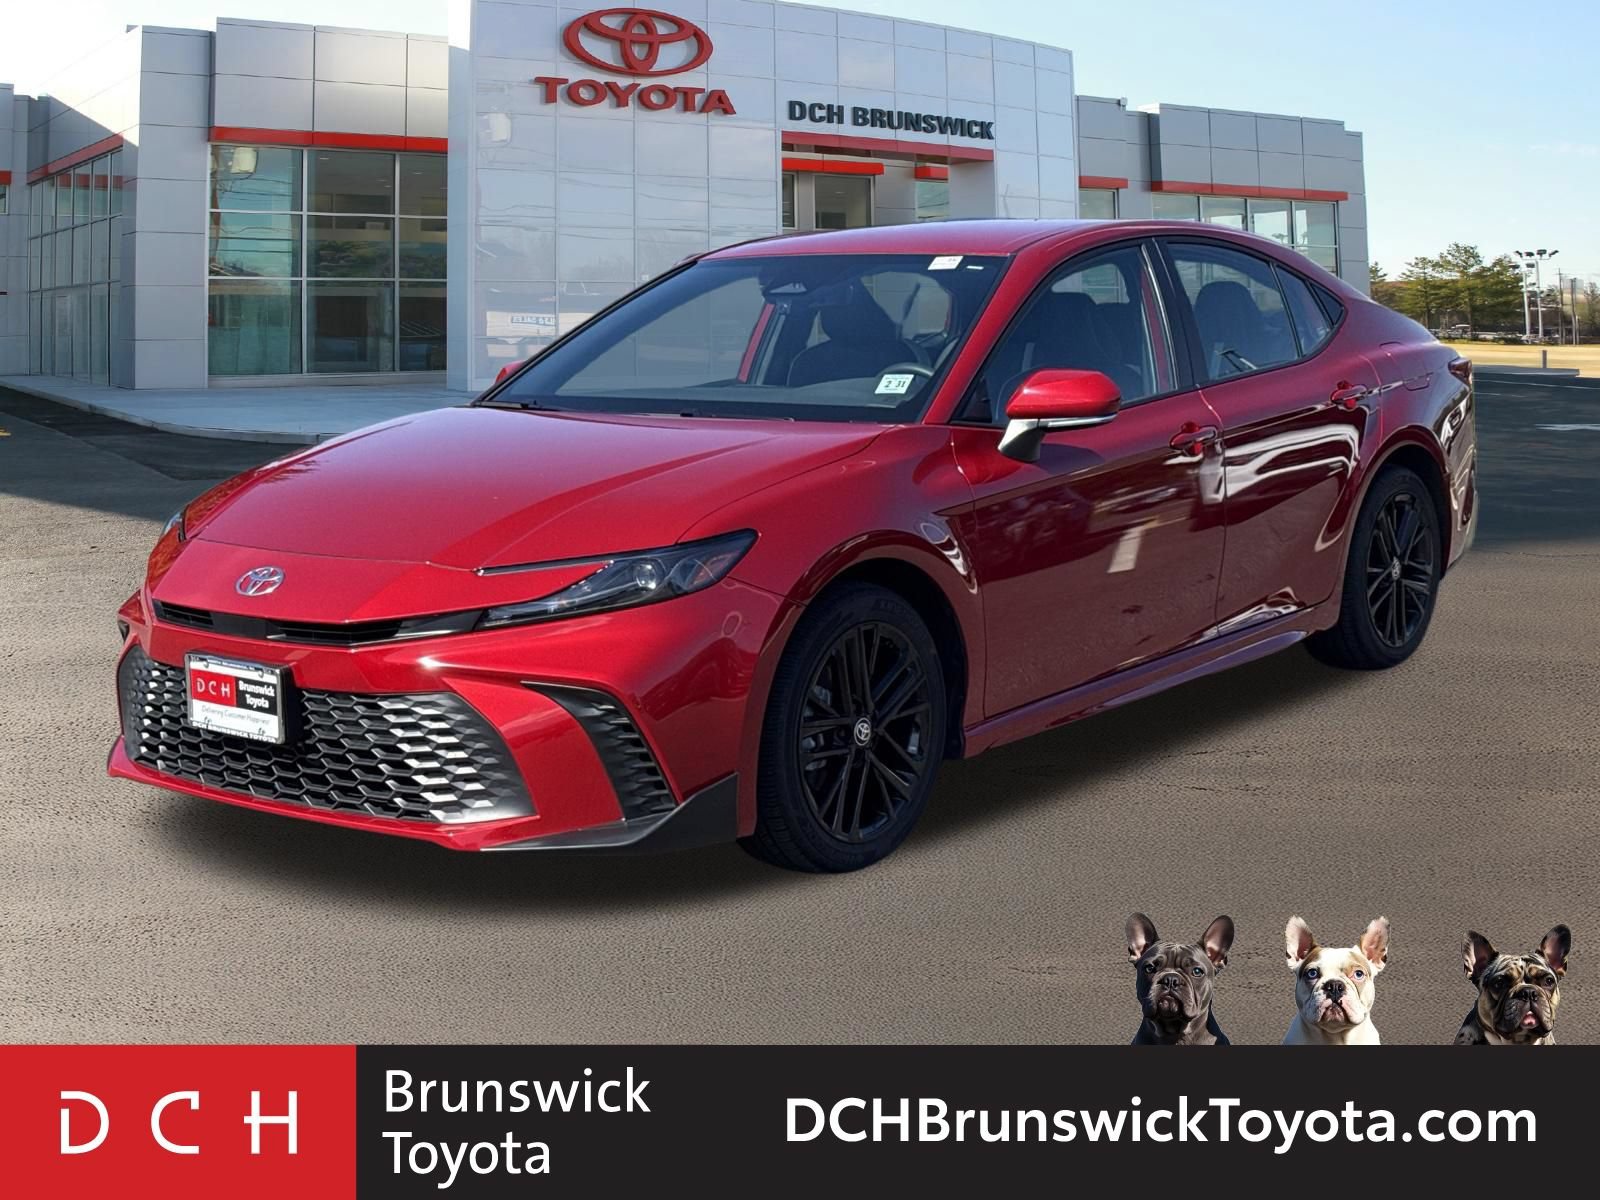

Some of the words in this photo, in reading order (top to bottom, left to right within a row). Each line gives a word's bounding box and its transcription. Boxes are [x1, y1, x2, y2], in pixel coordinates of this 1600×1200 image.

[534, 76, 737, 115] TOYOTA
[788, 100, 845, 125] DCH
[852, 106, 995, 140] BRUNSWICK
[238, 680, 276, 697] Brunswick
[245, 693, 270, 709] Toyota
